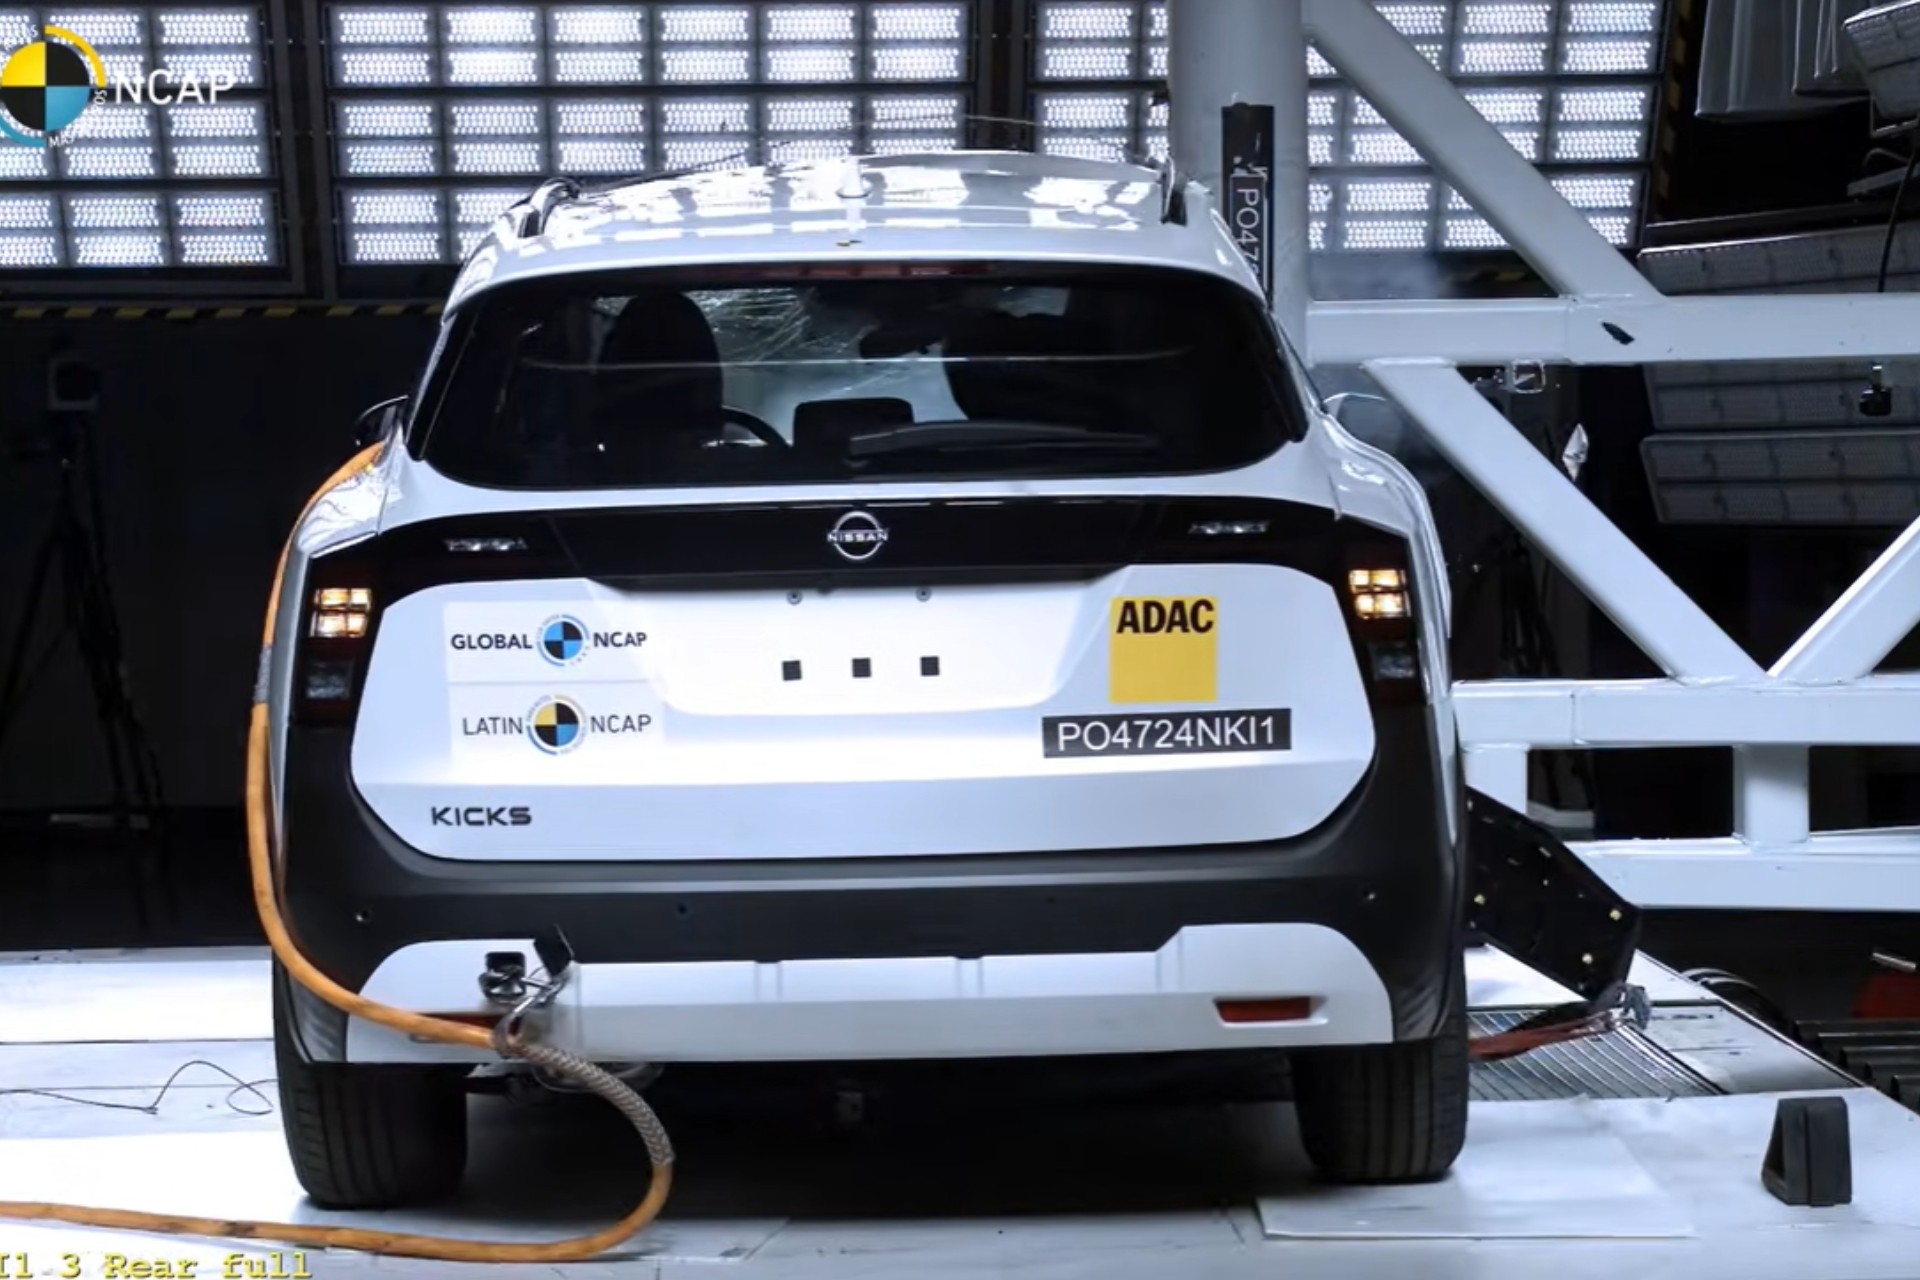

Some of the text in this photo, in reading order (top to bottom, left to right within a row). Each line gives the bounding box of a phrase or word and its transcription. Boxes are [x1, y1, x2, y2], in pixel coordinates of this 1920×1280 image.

[827, 529, 889, 543] NISSAN
[1116, 599, 1215, 634] ADAC
[450, 631, 647, 650] GLOBAL NCAP
[462, 714, 652, 736] LATIN NCAP
[1057, 715, 1275, 752] PO4724NKI1
[431, 806, 532, 826] KICKS
